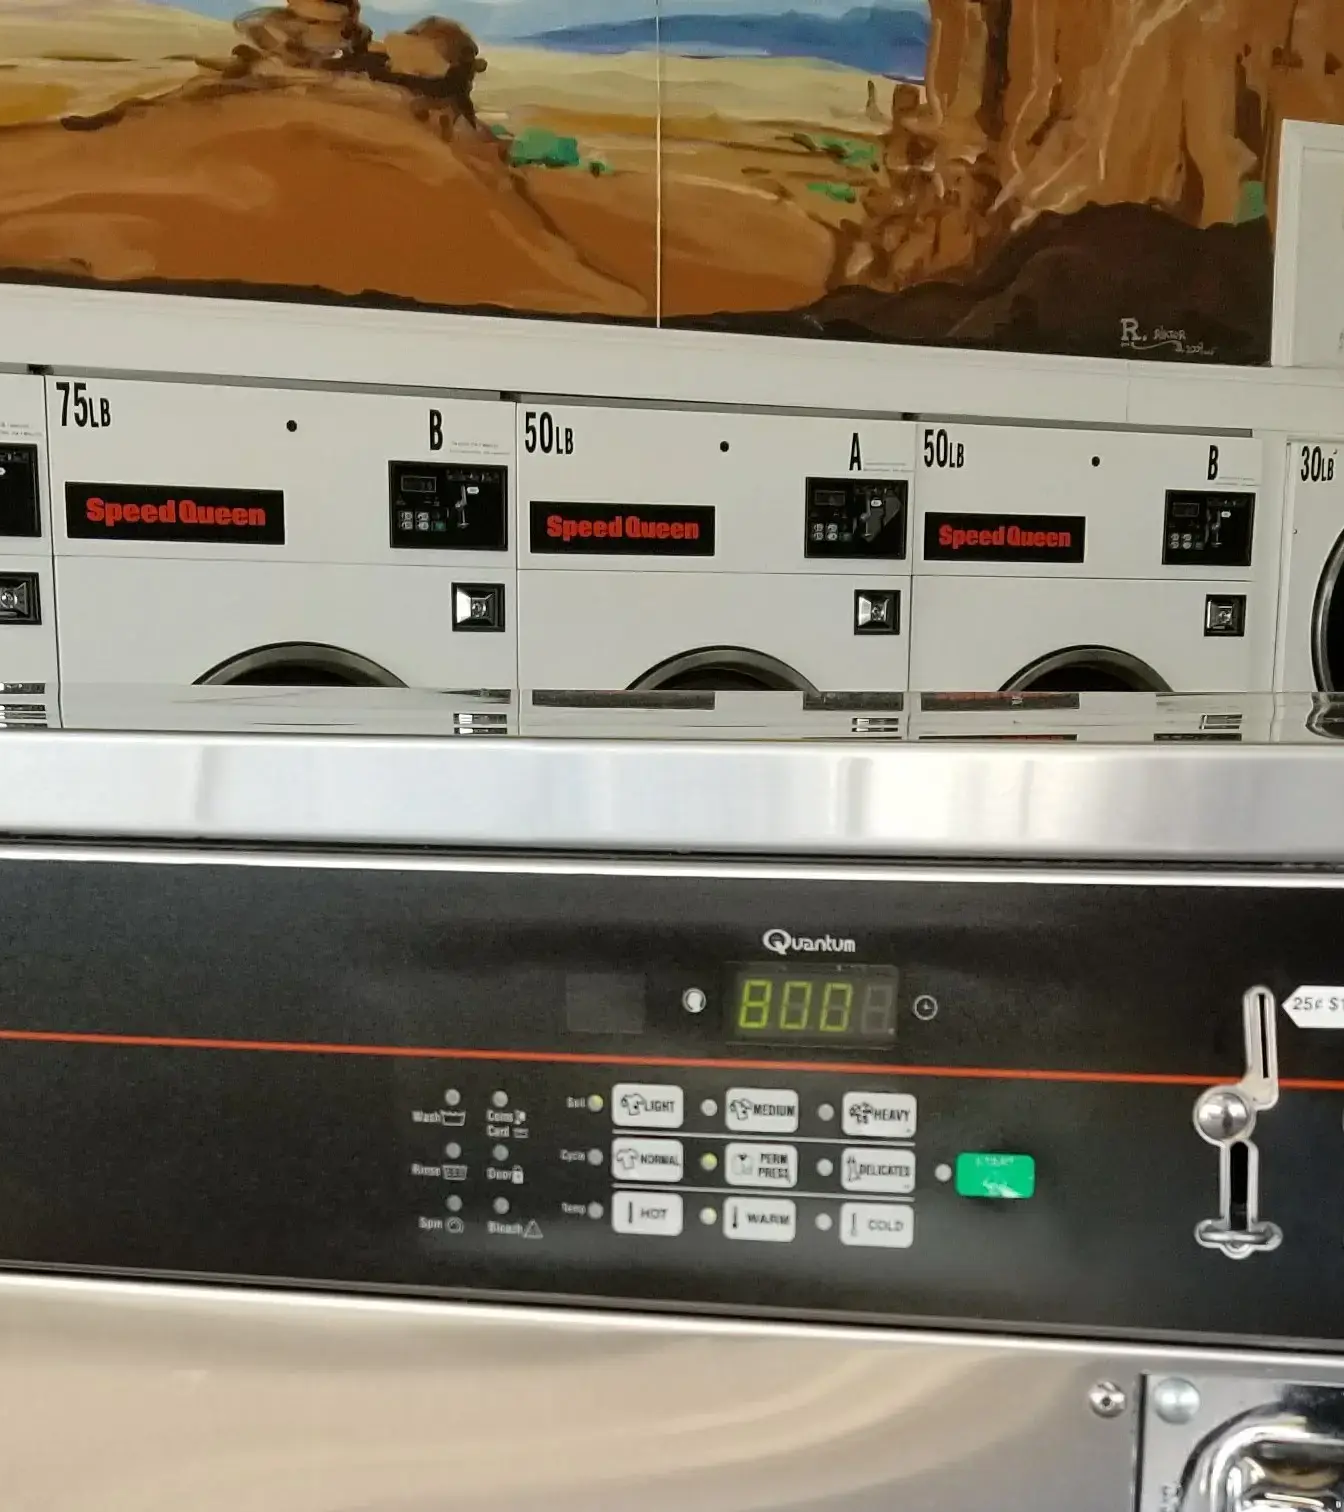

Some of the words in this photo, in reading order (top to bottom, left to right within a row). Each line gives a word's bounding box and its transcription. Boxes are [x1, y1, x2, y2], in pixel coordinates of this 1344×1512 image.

[56, 382, 112, 428] 75LB
[429, 409, 444, 451] B
[524, 412, 574, 455] 50LB
[849, 432, 862, 471] A
[924, 429, 965, 469] 50LB
[1208, 445, 1219, 480] B
[85, 497, 176, 527] Speed
[179, 499, 266, 527] Queen
[546, 514, 623, 541] Speed
[625, 515, 699, 541] Queen
[939, 524, 1005, 549] Speed
[1007, 525, 1071, 548] Queen
[762, 928, 856, 955] Quantum
[644, 1100, 675, 1113] LIGHT
[753, 1104, 795, 1117] MEDIUM
[874, 1108, 910, 1121] HEAVY
[412, 1110, 441, 1123] Wash
[641, 1154, 680, 1167] NORMAL
[760, 1153, 788, 1164] PERM
[859, 1164, 910, 1177] DELICATES
[641, 1208, 668, 1220] HOT
[747, 1213, 790, 1225] WARM
[868, 1219, 904, 1231] COLD
